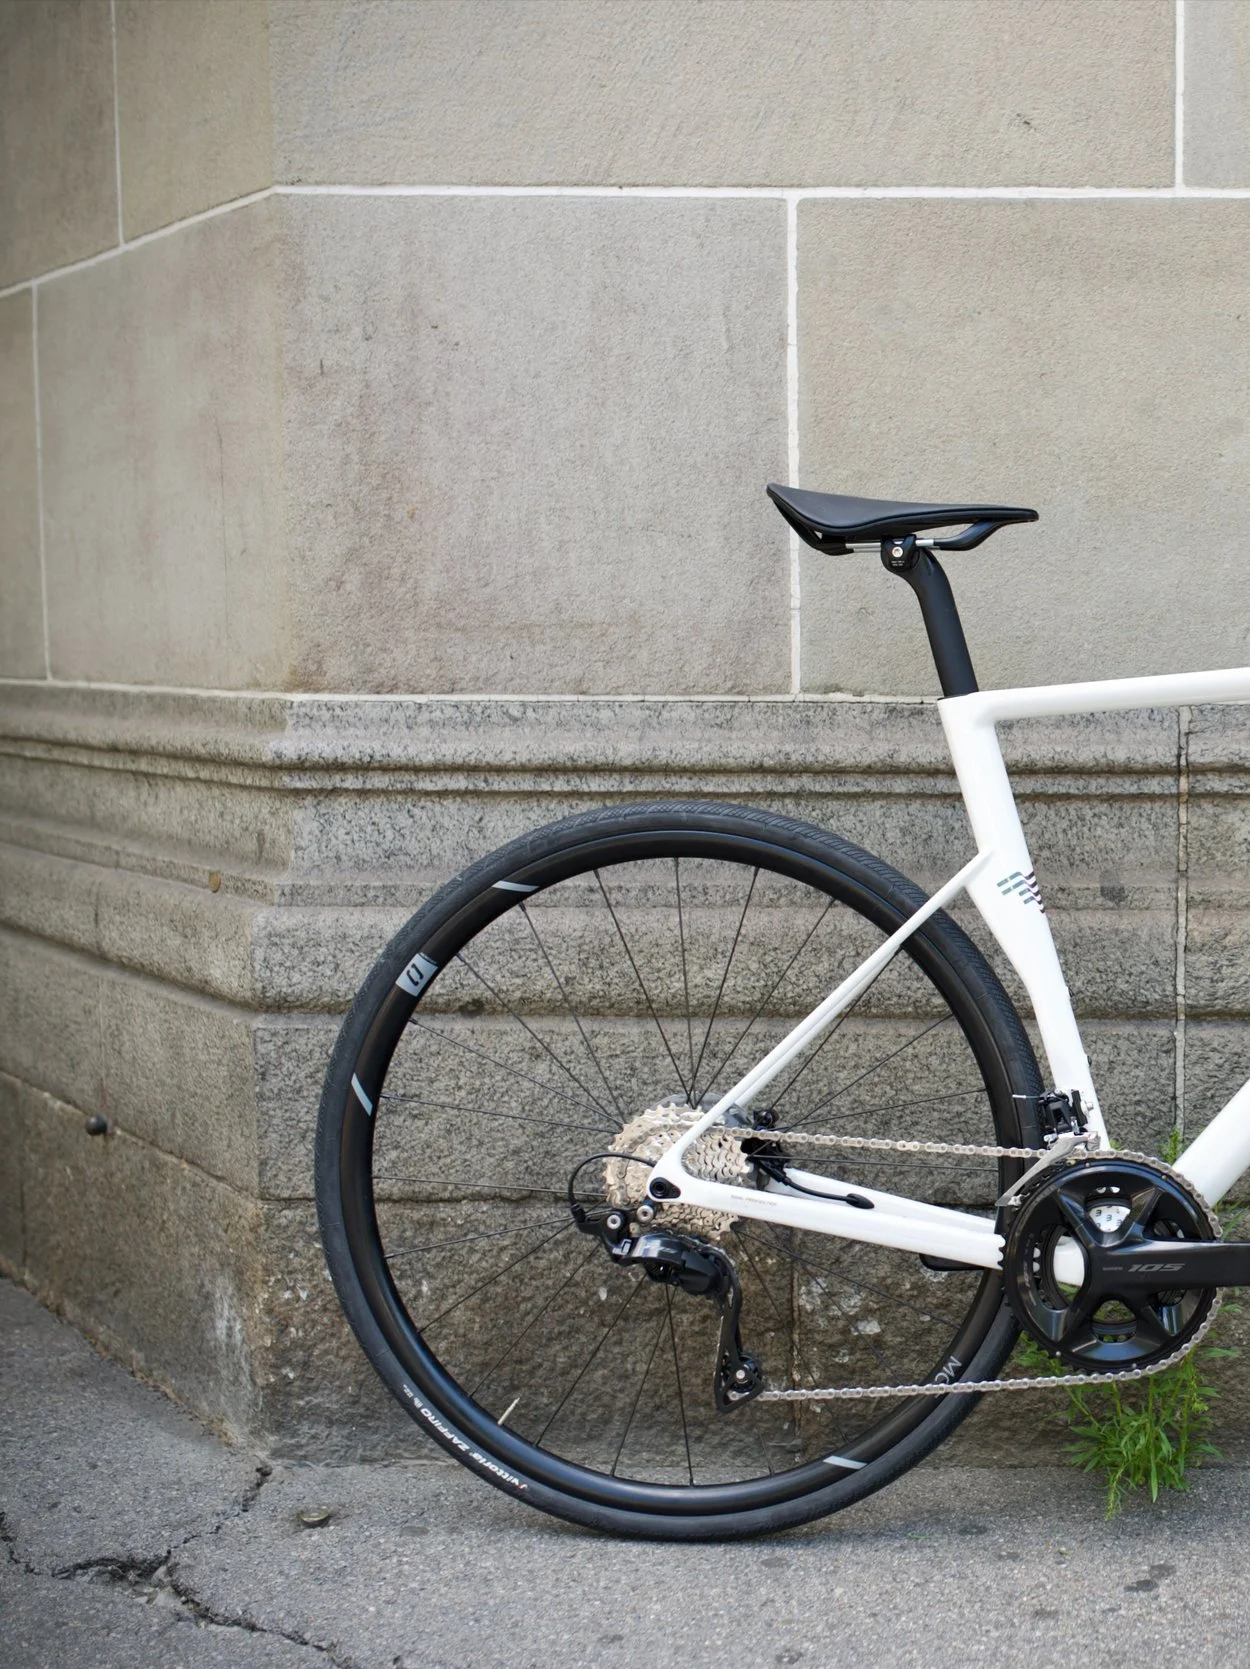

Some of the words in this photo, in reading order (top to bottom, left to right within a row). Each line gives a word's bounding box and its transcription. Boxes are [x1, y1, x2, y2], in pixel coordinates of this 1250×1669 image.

[1128, 1264, 1186, 1272] 105
[934, 1356, 962, 1398] MC
[420, 1408, 470, 1452] ZAFFIRO
